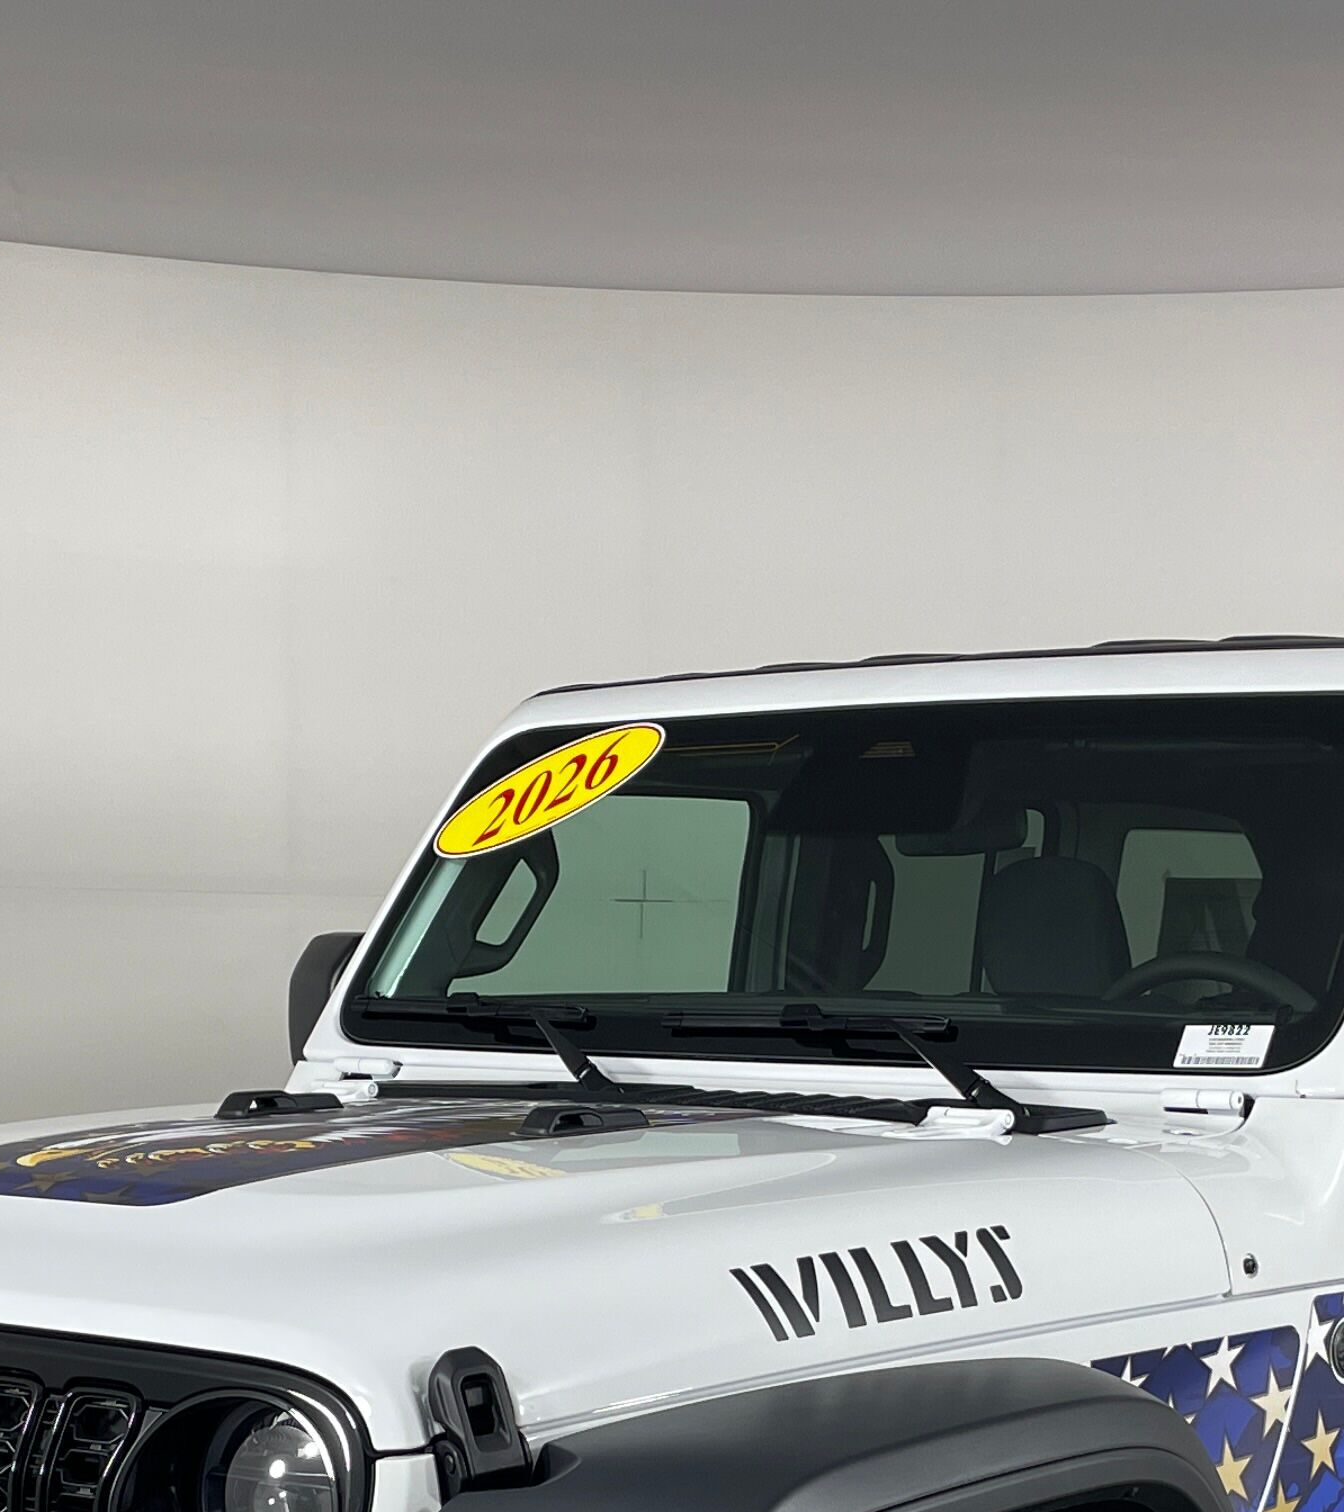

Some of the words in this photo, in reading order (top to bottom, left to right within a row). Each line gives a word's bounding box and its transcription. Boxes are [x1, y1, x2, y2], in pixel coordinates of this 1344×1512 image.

[471, 731, 631, 847] 2026
[1207, 1024, 1251, 1036] JE9822
[728, 1225, 1024, 1342] WILLYS
